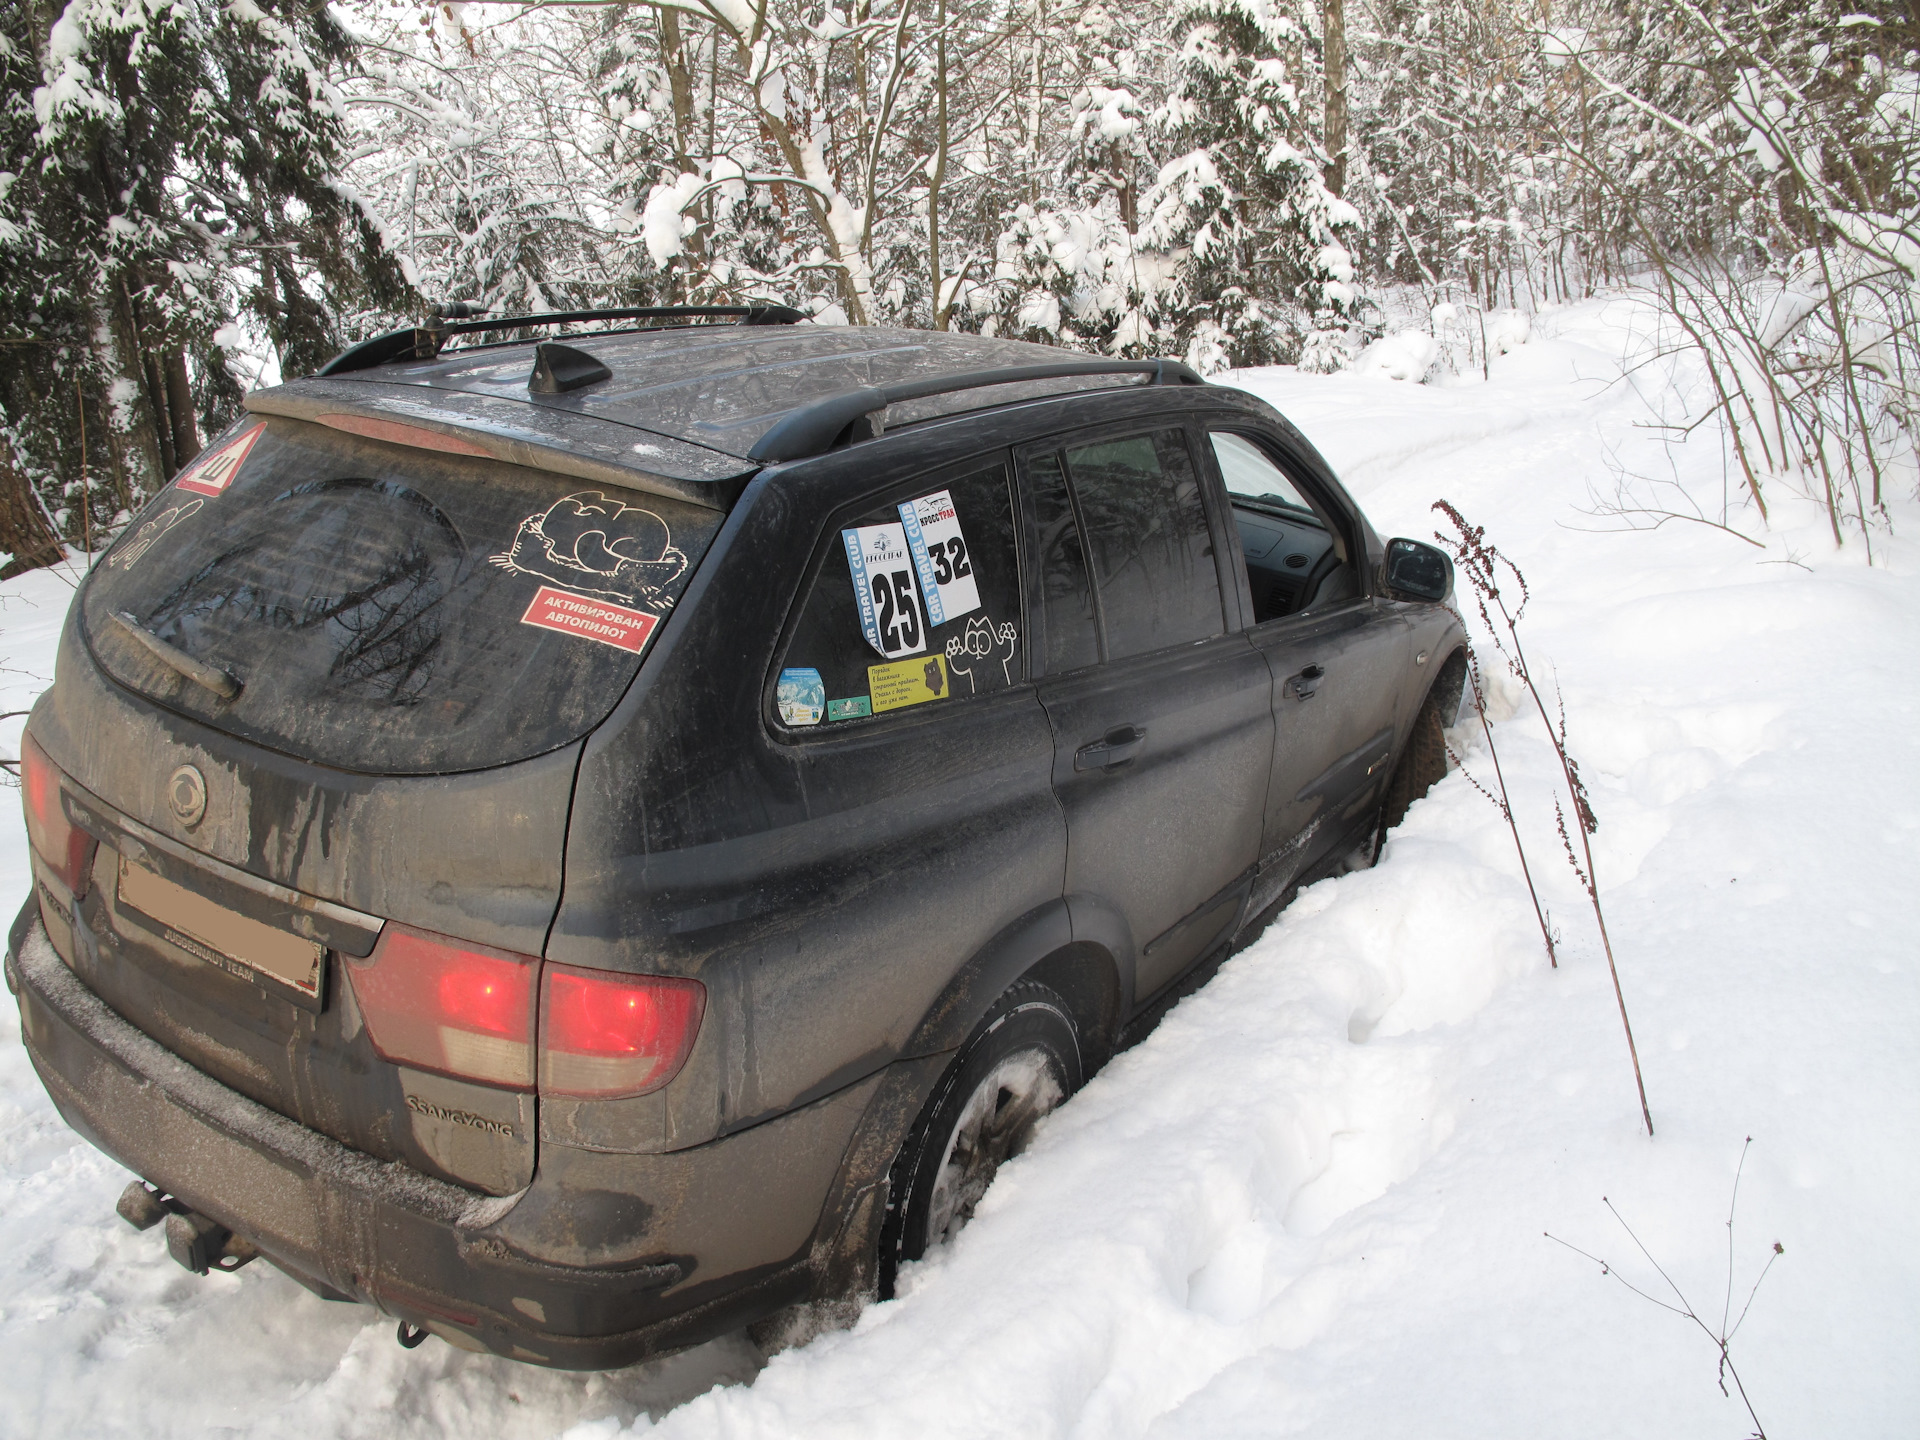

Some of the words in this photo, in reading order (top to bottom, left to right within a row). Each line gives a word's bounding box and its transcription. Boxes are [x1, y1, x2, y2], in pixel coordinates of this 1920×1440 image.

[199, 455, 236, 482] Ш
[901, 503, 921, 538] CLUB
[920, 508, 955, 527] КРОССТРАК
[847, 534, 863, 569] CLUB
[912, 540, 936, 592] TRAVEL
[927, 536, 972, 585] 32
[543, 596, 643, 631] АКТИВИРОВАН
[855, 571, 874, 626] TRAVEL
[871, 570, 920, 653] 25
[928, 593, 943, 623] CAR
[545, 611, 628, 640] АВТОПИЛОТ
[164, 929, 225, 968] JUGGERNAUT
[226, 960, 255, 983] TEAM
